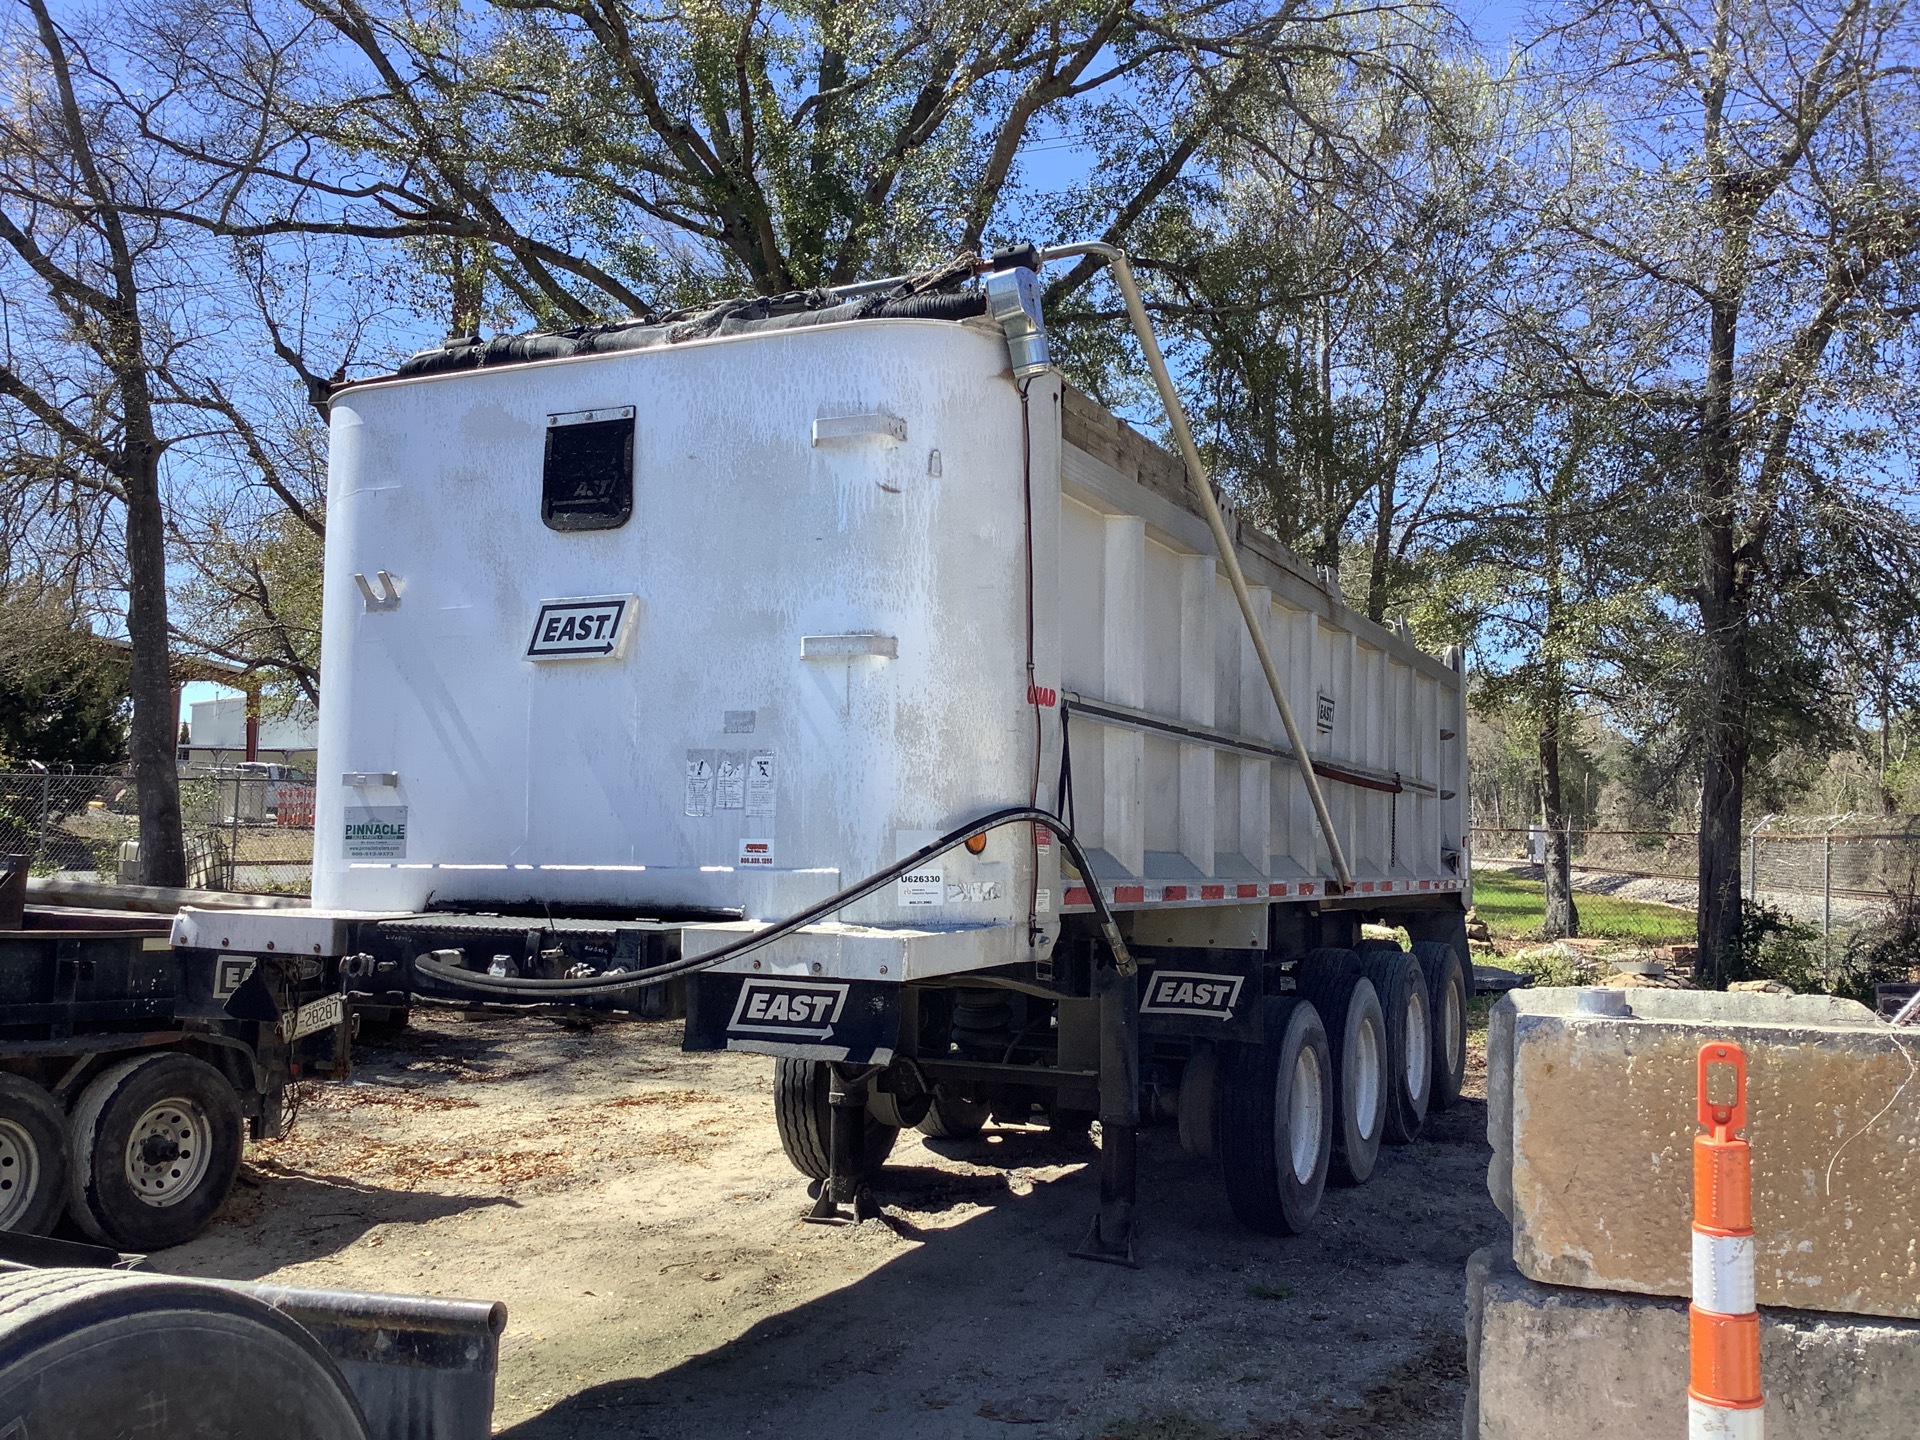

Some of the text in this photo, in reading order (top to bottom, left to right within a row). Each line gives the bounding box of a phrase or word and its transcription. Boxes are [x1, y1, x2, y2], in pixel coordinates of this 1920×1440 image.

[1027, 685, 1056, 707] QUAD
[1320, 704, 1333, 722] EAST
[345, 824, 405, 835] PINNACLE
[901, 875, 941, 883] U626330
[1156, 982, 1230, 1006] EAST
[284, 996, 338, 1020] NOTH CAROLINA
[286, 1001, 339, 1035] A-28287
[746, 993, 834, 1022] EAST
